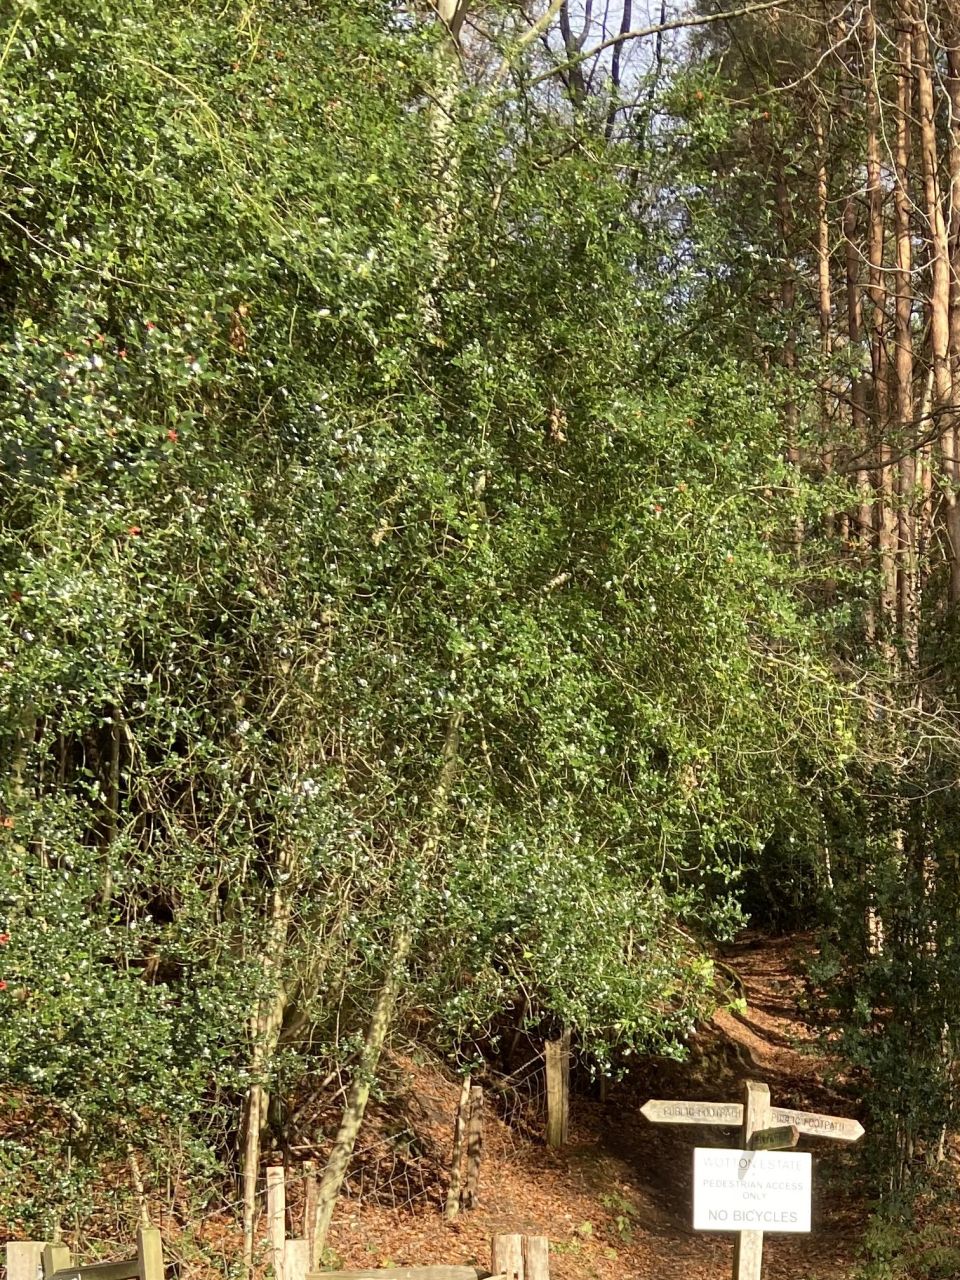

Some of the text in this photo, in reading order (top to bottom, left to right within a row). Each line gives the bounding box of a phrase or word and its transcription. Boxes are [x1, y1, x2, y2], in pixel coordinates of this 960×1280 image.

[771, 1112, 845, 1131] PUBLIC FOOTPATH
[703, 1157, 801, 1171] WOTTON ESTATE
[703, 1179, 804, 1191] PEDESTRIAN ACCESS
[742, 1191, 766, 1201] ONLY
[708, 1209, 798, 1223] NO BICYCLES
